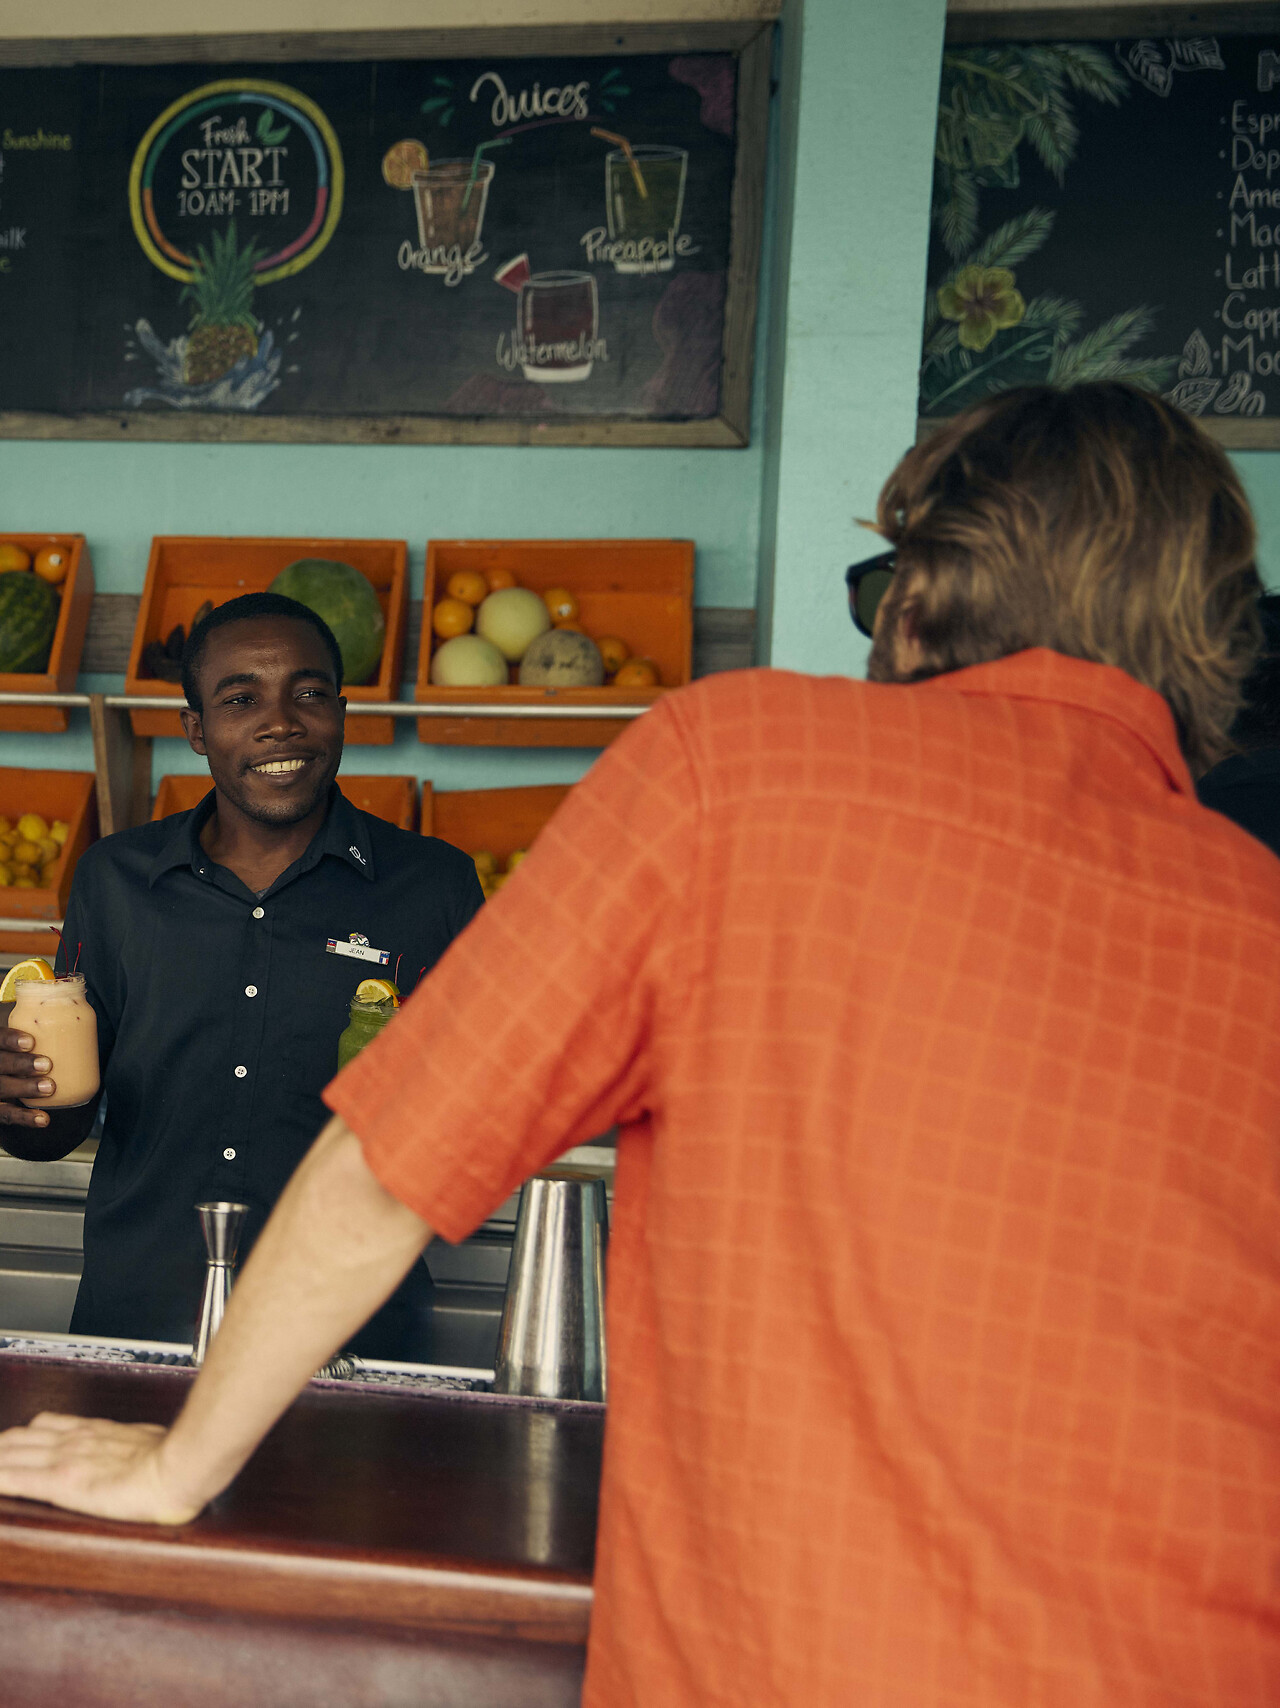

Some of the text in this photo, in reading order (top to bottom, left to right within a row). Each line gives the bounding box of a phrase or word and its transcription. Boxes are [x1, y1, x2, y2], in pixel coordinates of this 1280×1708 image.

[471, 72, 590, 126] Juices
[2, 128, 72, 150] Sunshine
[200, 115, 252, 148] Fresh
[181, 146, 289, 189] START
[248, 188, 289, 216] 1PM
[397, 239, 490, 287] Orange
[580, 226, 704, 276] Pineapple
[496, 329, 609, 372] Watermelon
